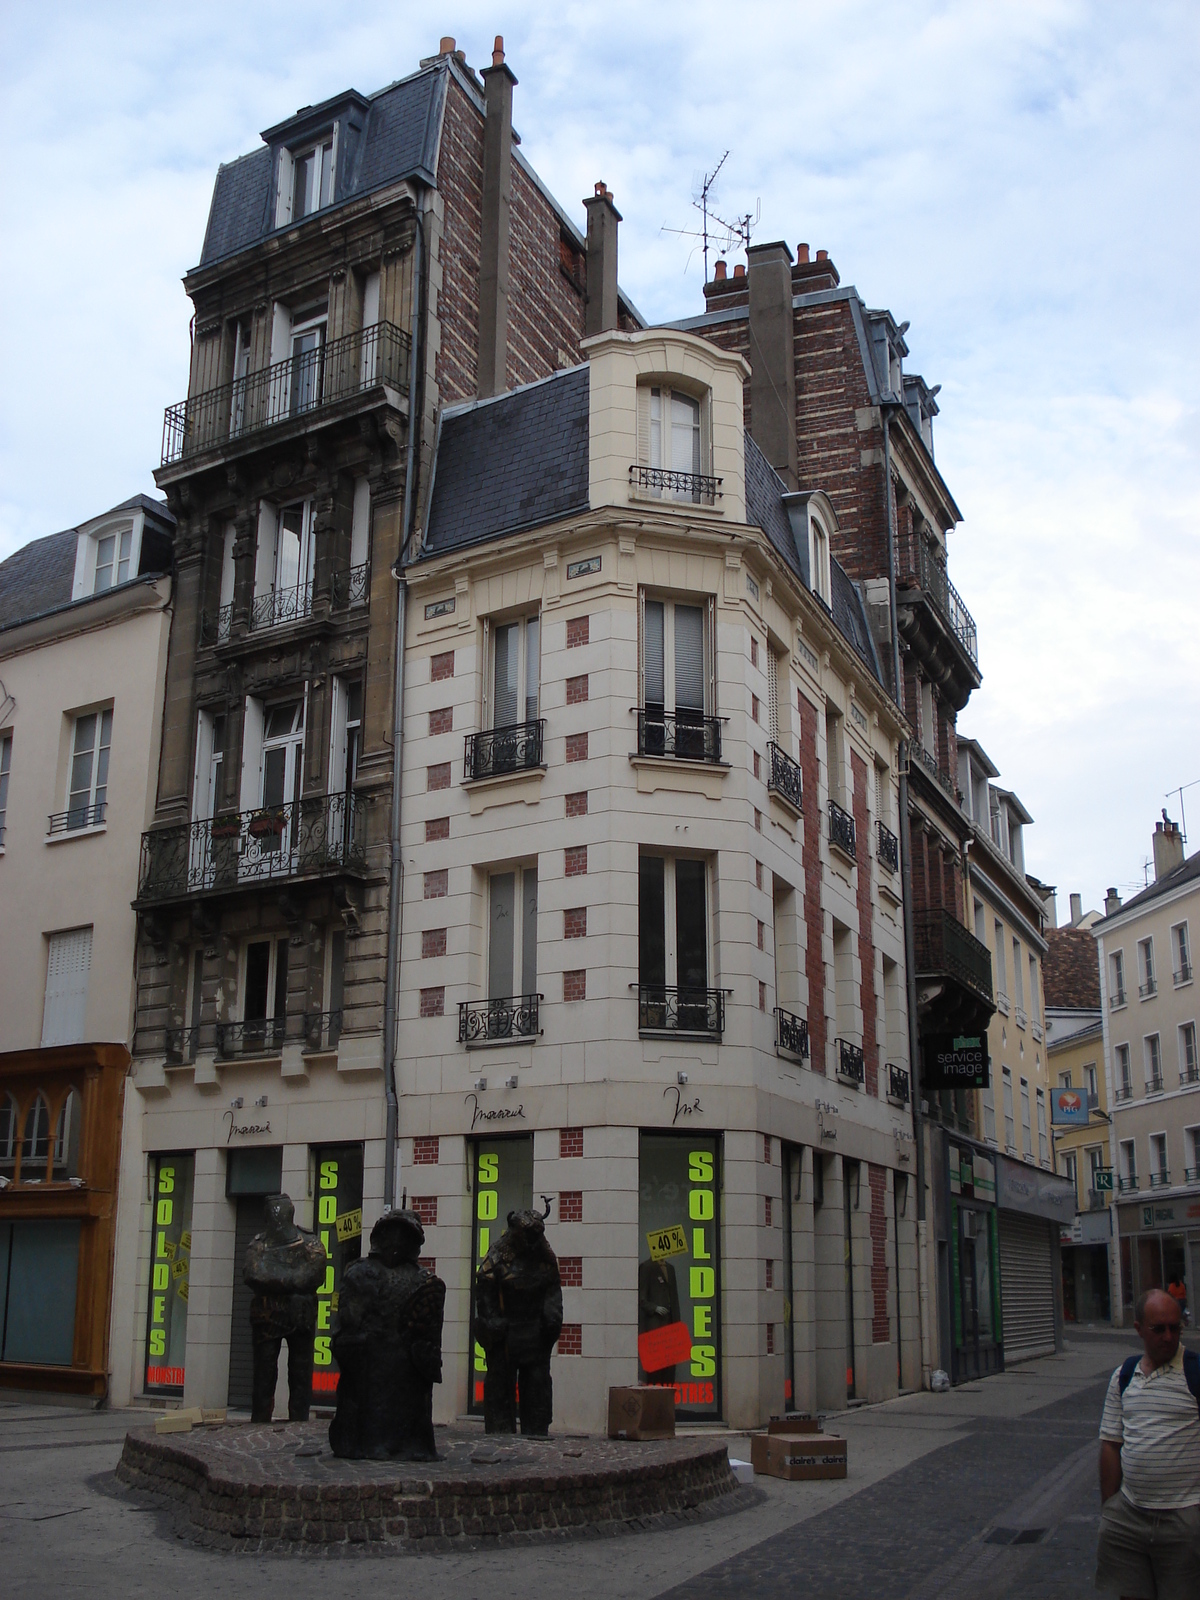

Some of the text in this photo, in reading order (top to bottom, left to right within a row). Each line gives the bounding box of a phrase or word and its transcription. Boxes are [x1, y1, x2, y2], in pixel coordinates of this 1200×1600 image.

[937, 1050, 983, 1064] service
[943, 1062, 983, 1077] image
[1063, 1105, 1078, 1113] PFG
[343, 1218, 353, 1232] 40
[658, 1234, 671, 1251] 40
[672, 1231, 684, 1248] %
[149, 1167, 175, 1356] SOLDES
[688, 1151, 716, 1377] SOLDES
[789, 1456, 816, 1466] claire's
